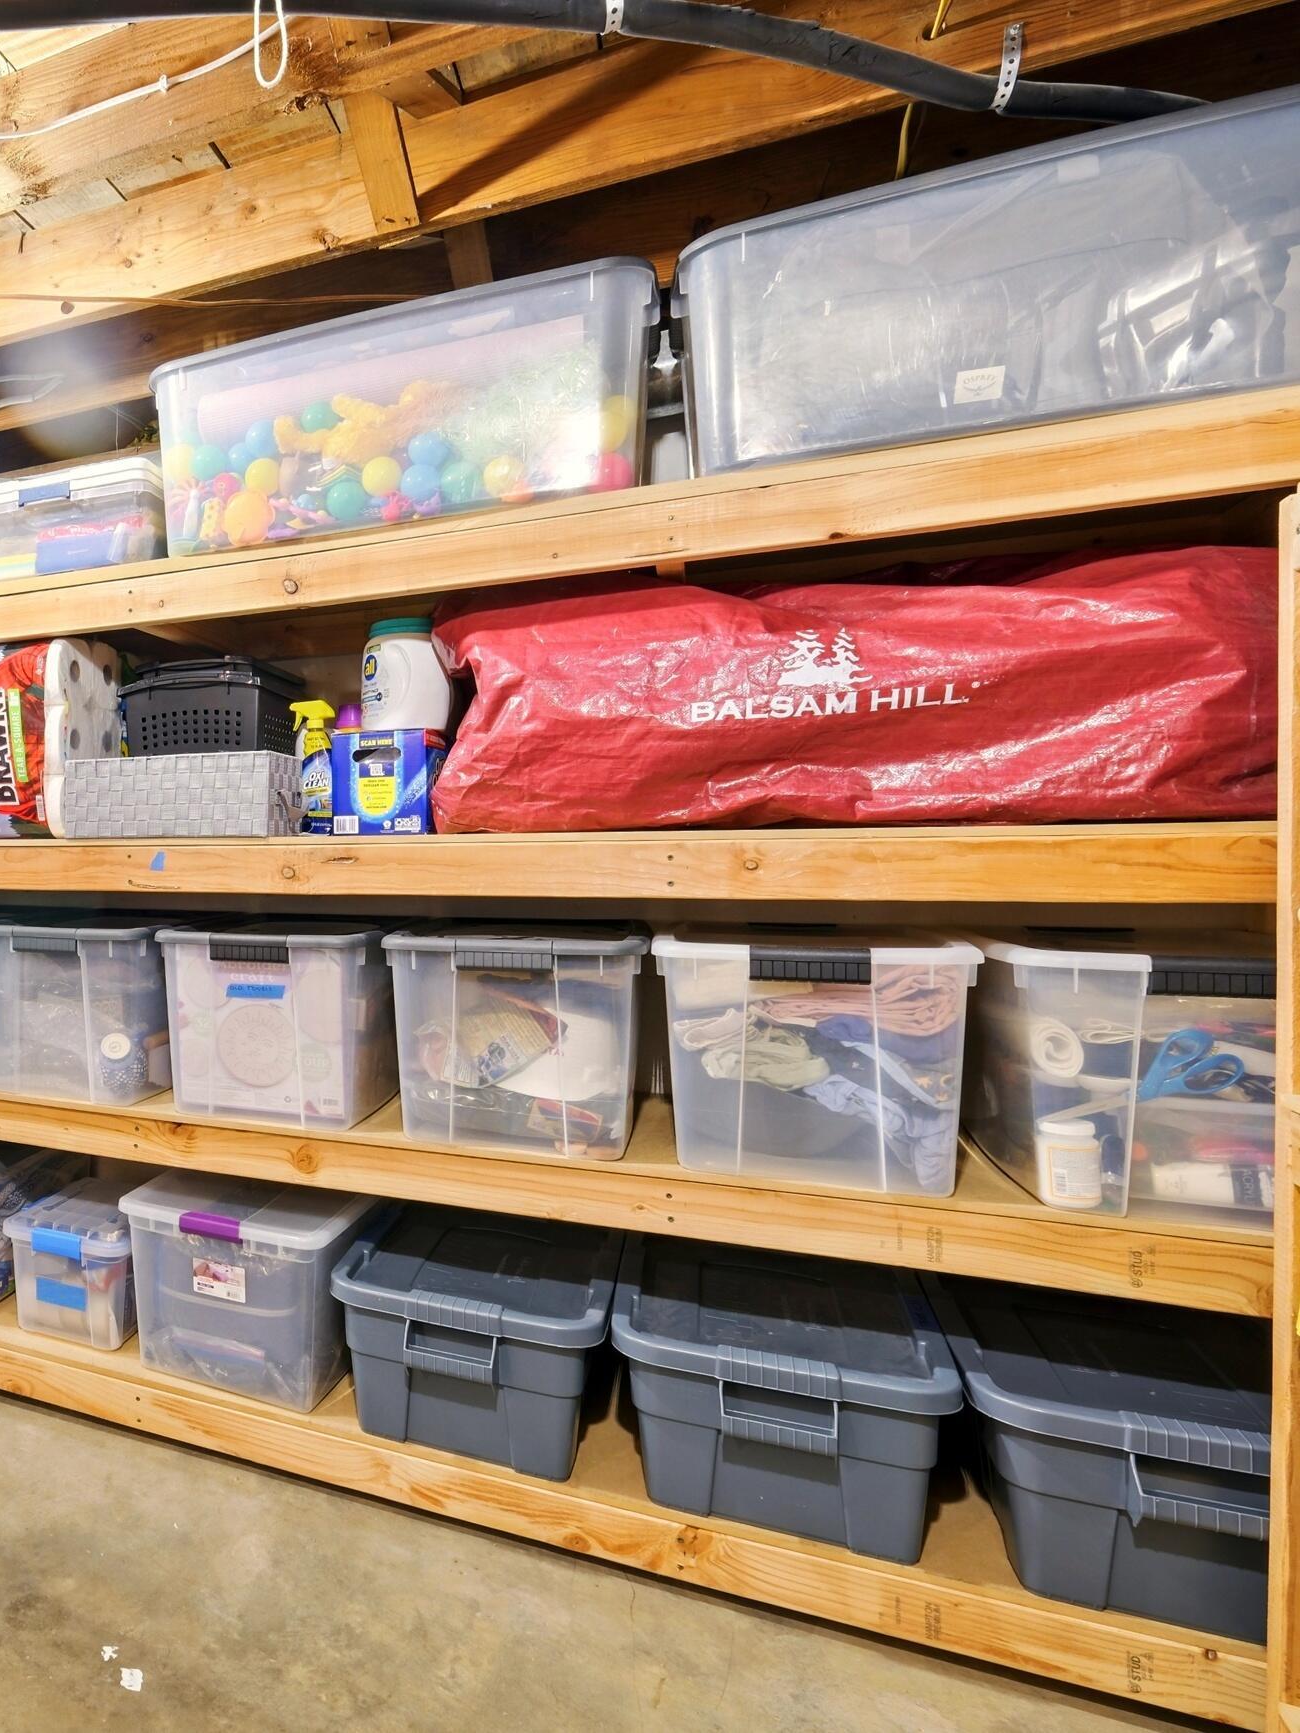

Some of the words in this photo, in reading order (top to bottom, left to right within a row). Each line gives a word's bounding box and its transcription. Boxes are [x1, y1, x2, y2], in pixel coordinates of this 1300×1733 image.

[364, 658, 376, 676] all
[690, 691, 857, 722] BALSAM
[10, 711, 26, 778] TEAR-A-SQUARE
[303, 778, 329, 790] CLEAN
[309, 772, 324, 781] OXI
[926, 1226, 935, 1263] HAMPTON
[1131, 1251, 1143, 1276] STUD
[924, 1601, 933, 1641] HAMPTON
[1130, 1656, 1141, 1682] STUD
